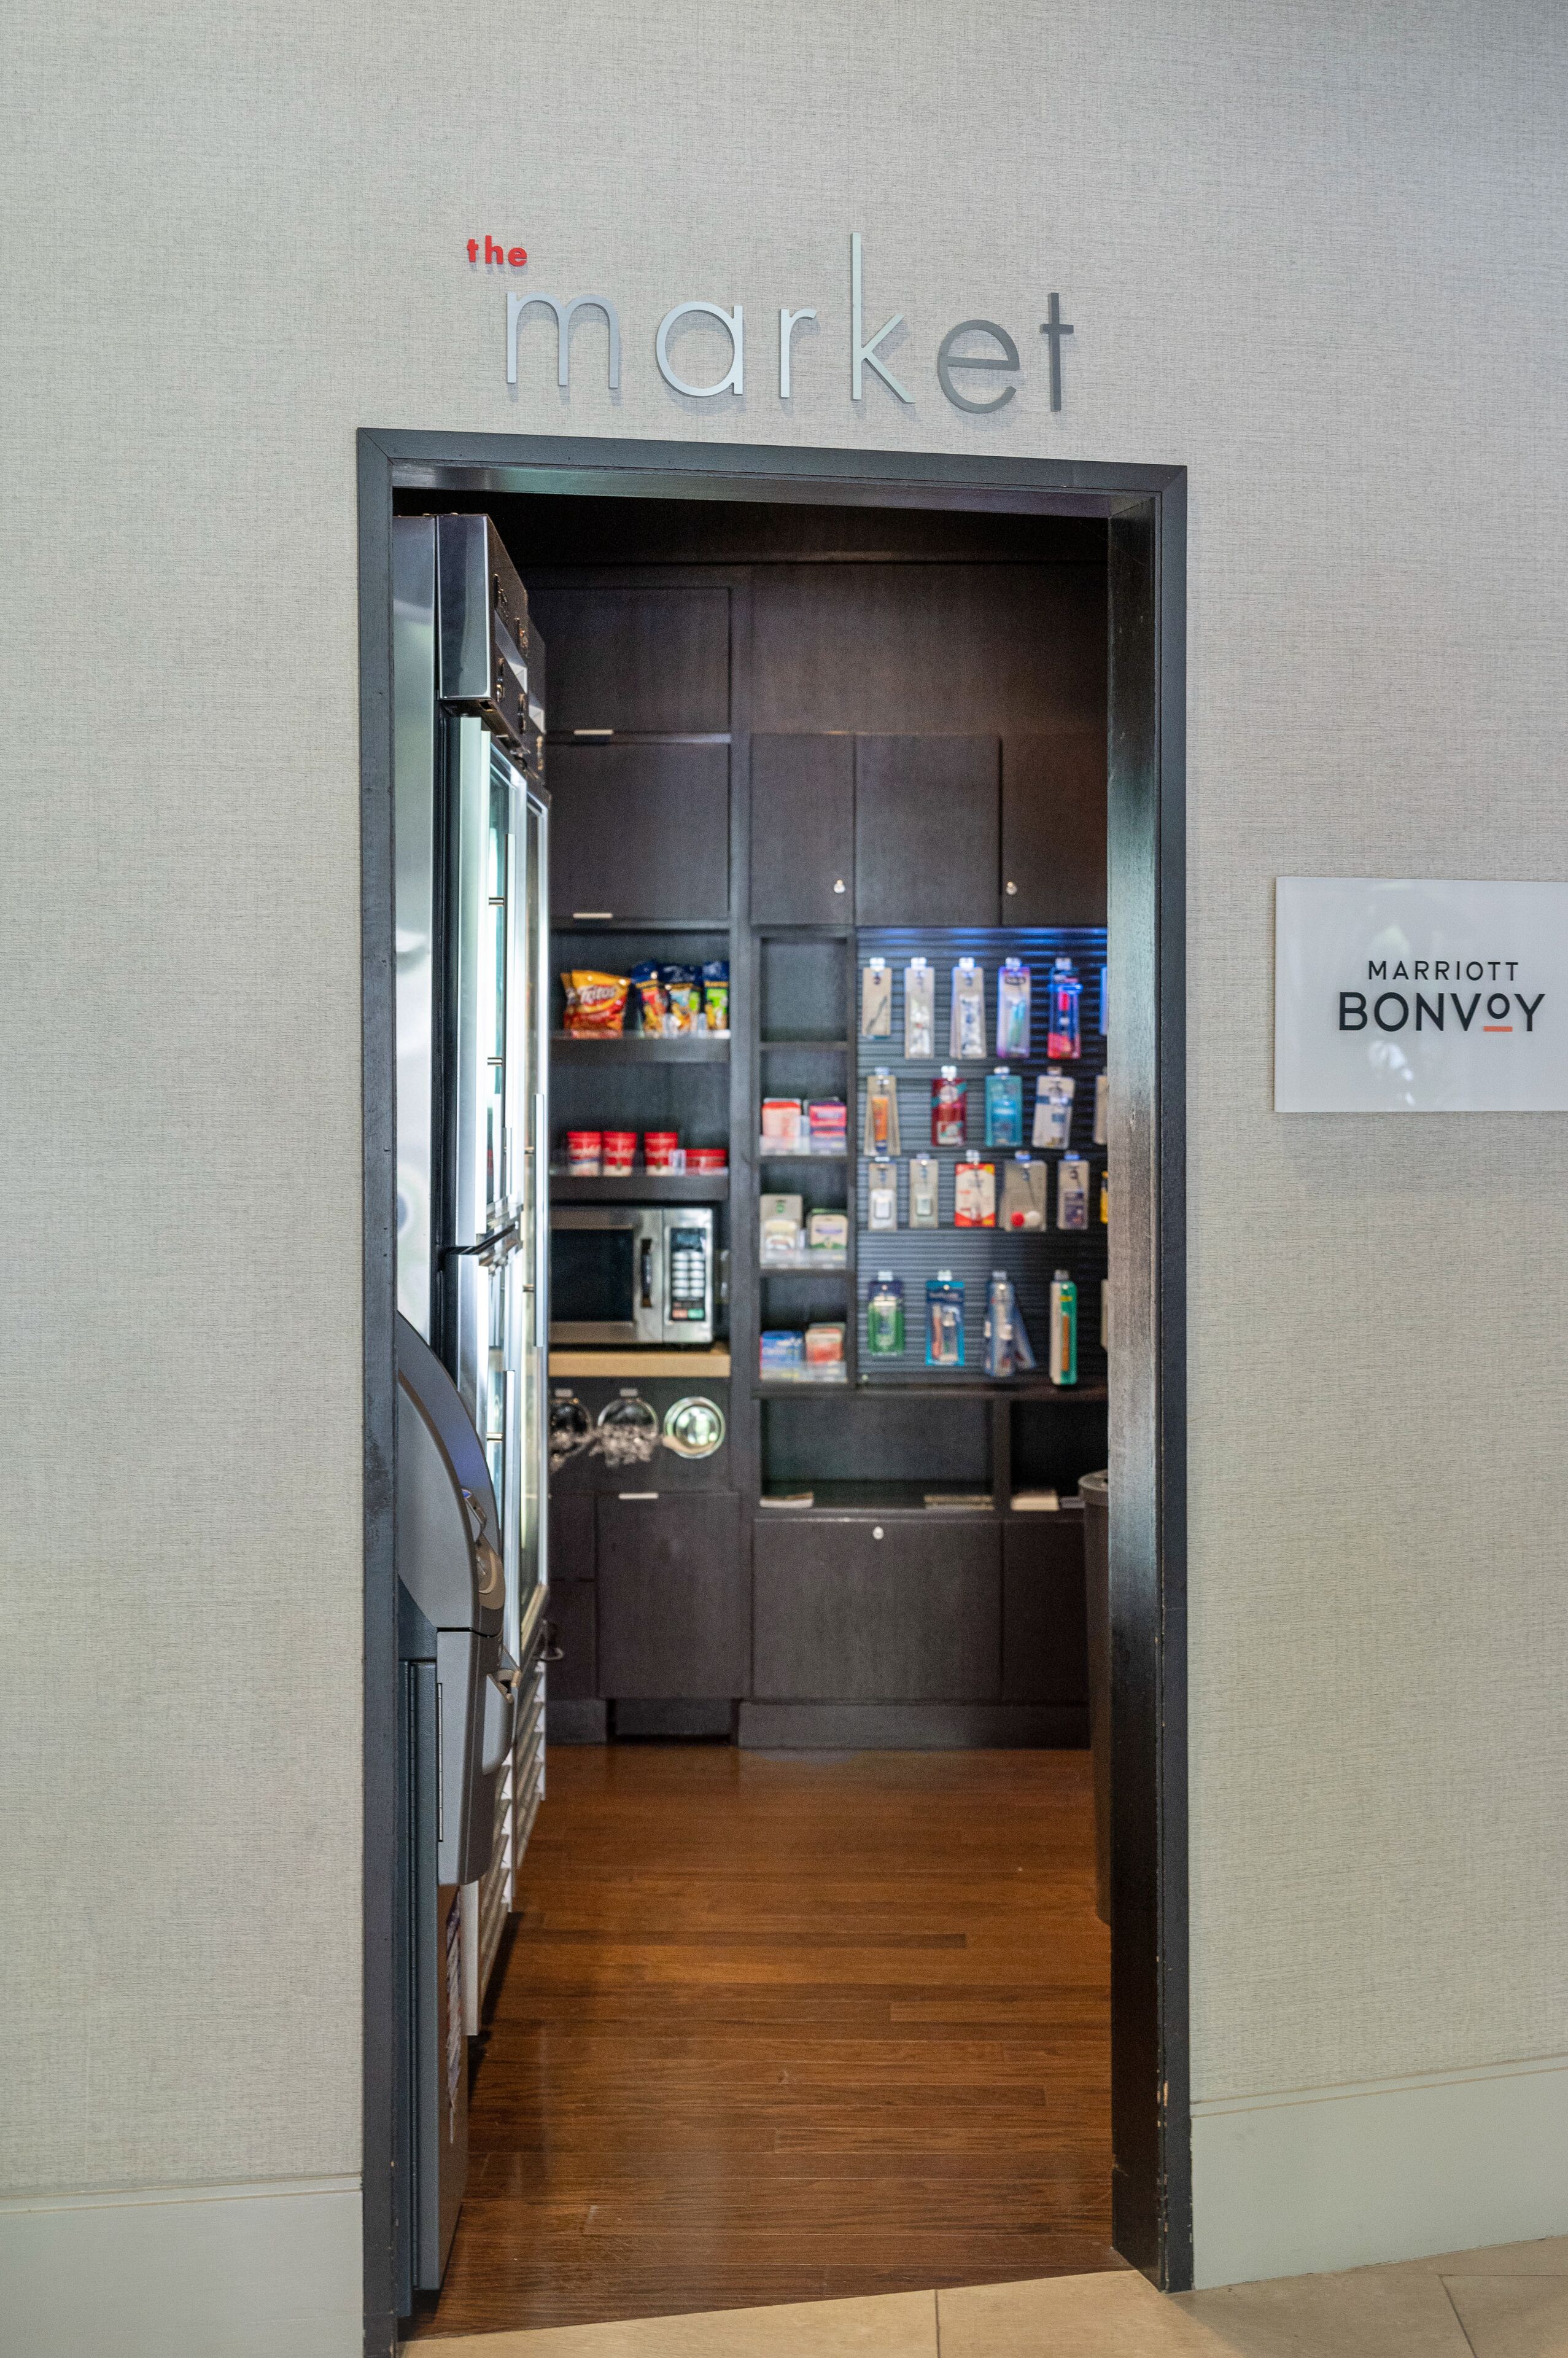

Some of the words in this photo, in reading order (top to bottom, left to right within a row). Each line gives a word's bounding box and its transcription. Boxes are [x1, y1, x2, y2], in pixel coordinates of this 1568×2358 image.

[467, 235, 527, 267] the
[507, 232, 1074, 414] market
[1368, 960, 1518, 981] MARRIOTT
[1339, 992, 1545, 1032] BONVOY
